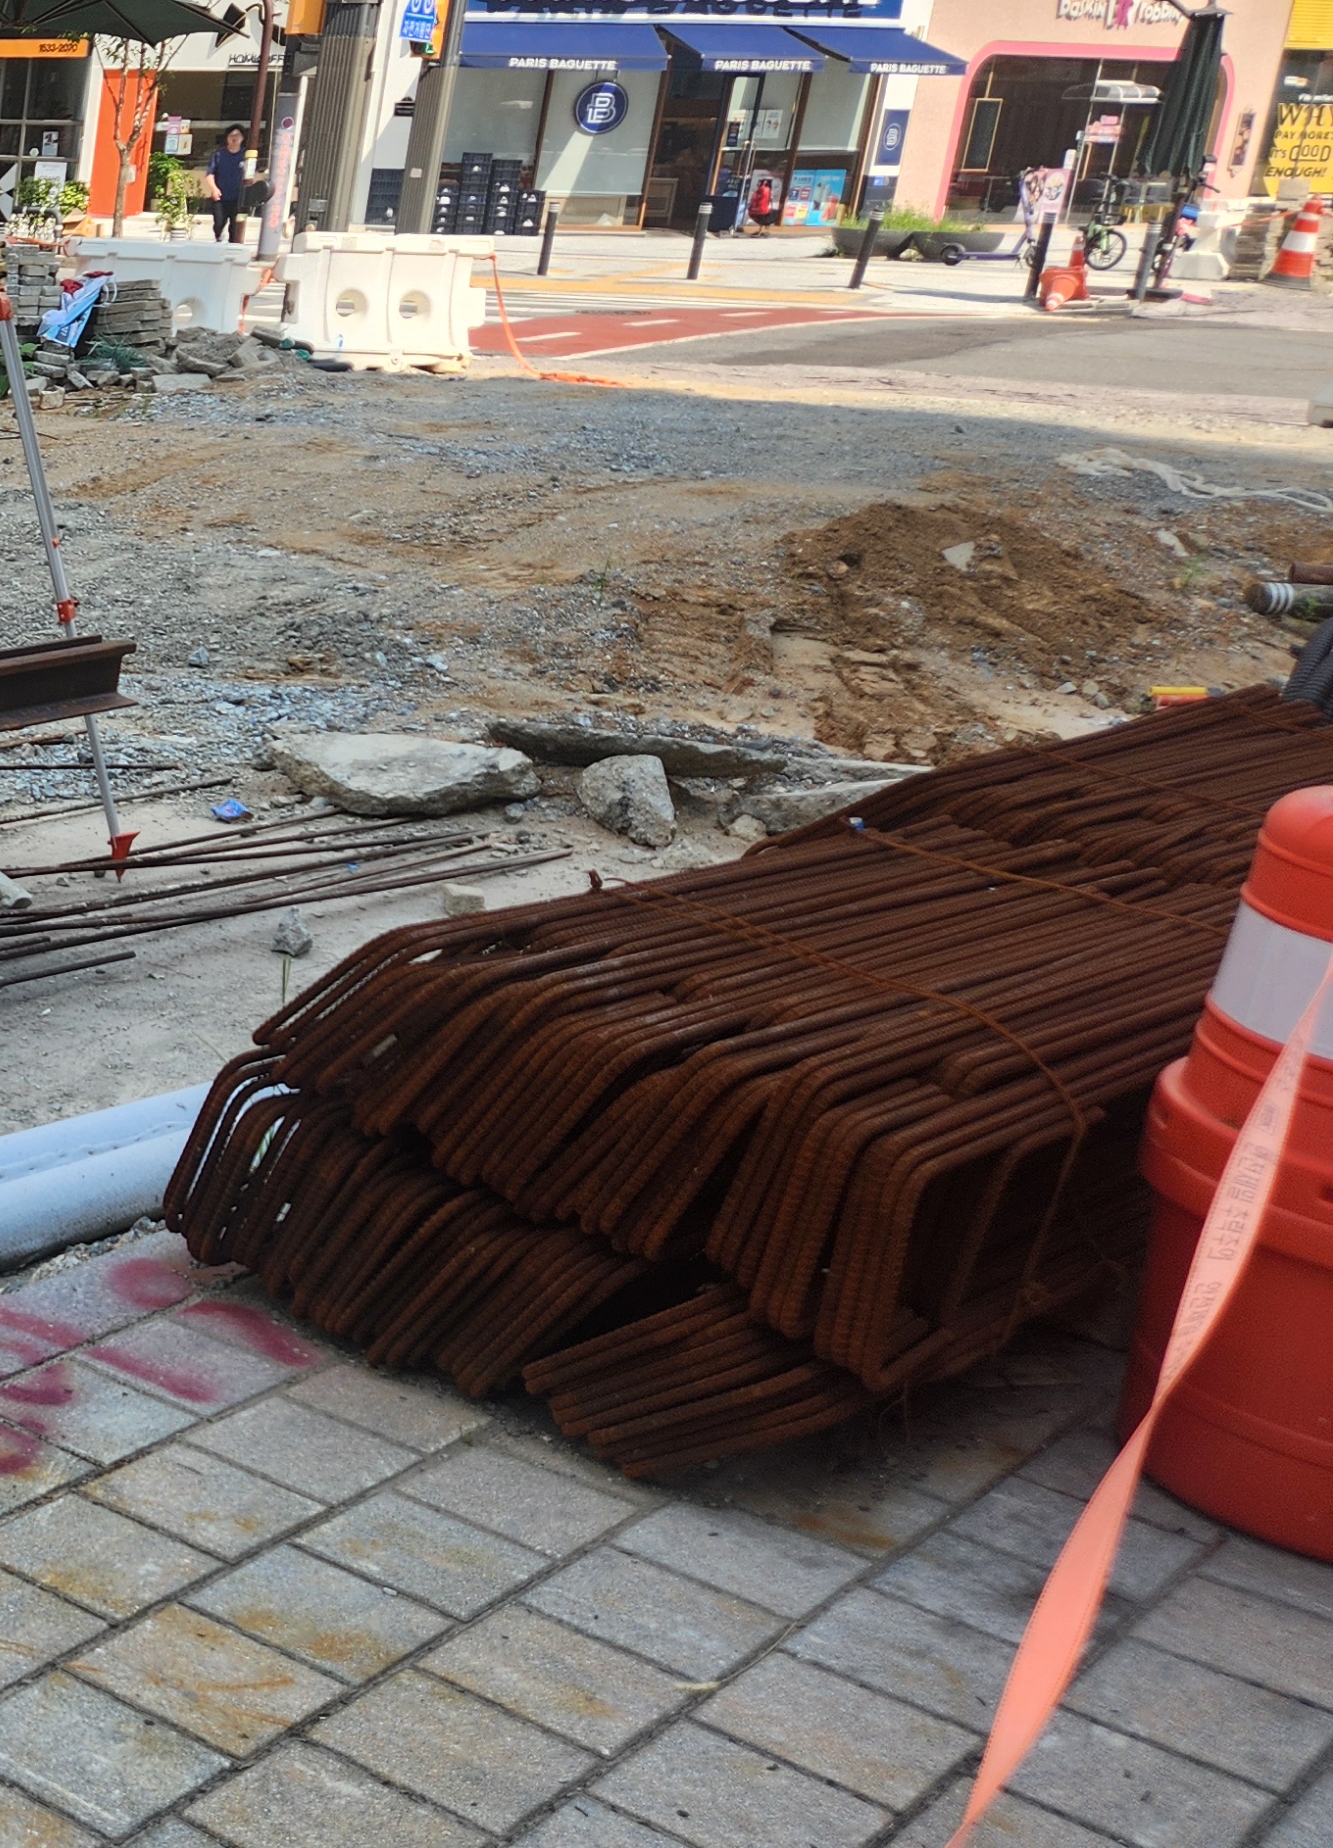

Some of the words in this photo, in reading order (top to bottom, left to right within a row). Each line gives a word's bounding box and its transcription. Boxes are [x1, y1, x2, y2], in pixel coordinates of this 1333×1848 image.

[508, 58, 548, 69] PARIS
[549, 58, 618, 71] BAGUETTE
[714, 60, 748, 71] PARIS
[750, 60, 811, 71] BAGUETTE
[870, 63, 897, 73] PARIS
[898, 63, 947, 75] BAGUETTE
[1274, 130, 1296, 140] PAY
[1289, 144, 1332, 162] GOOD
[1264, 166, 1329, 178] ENOUGH!
